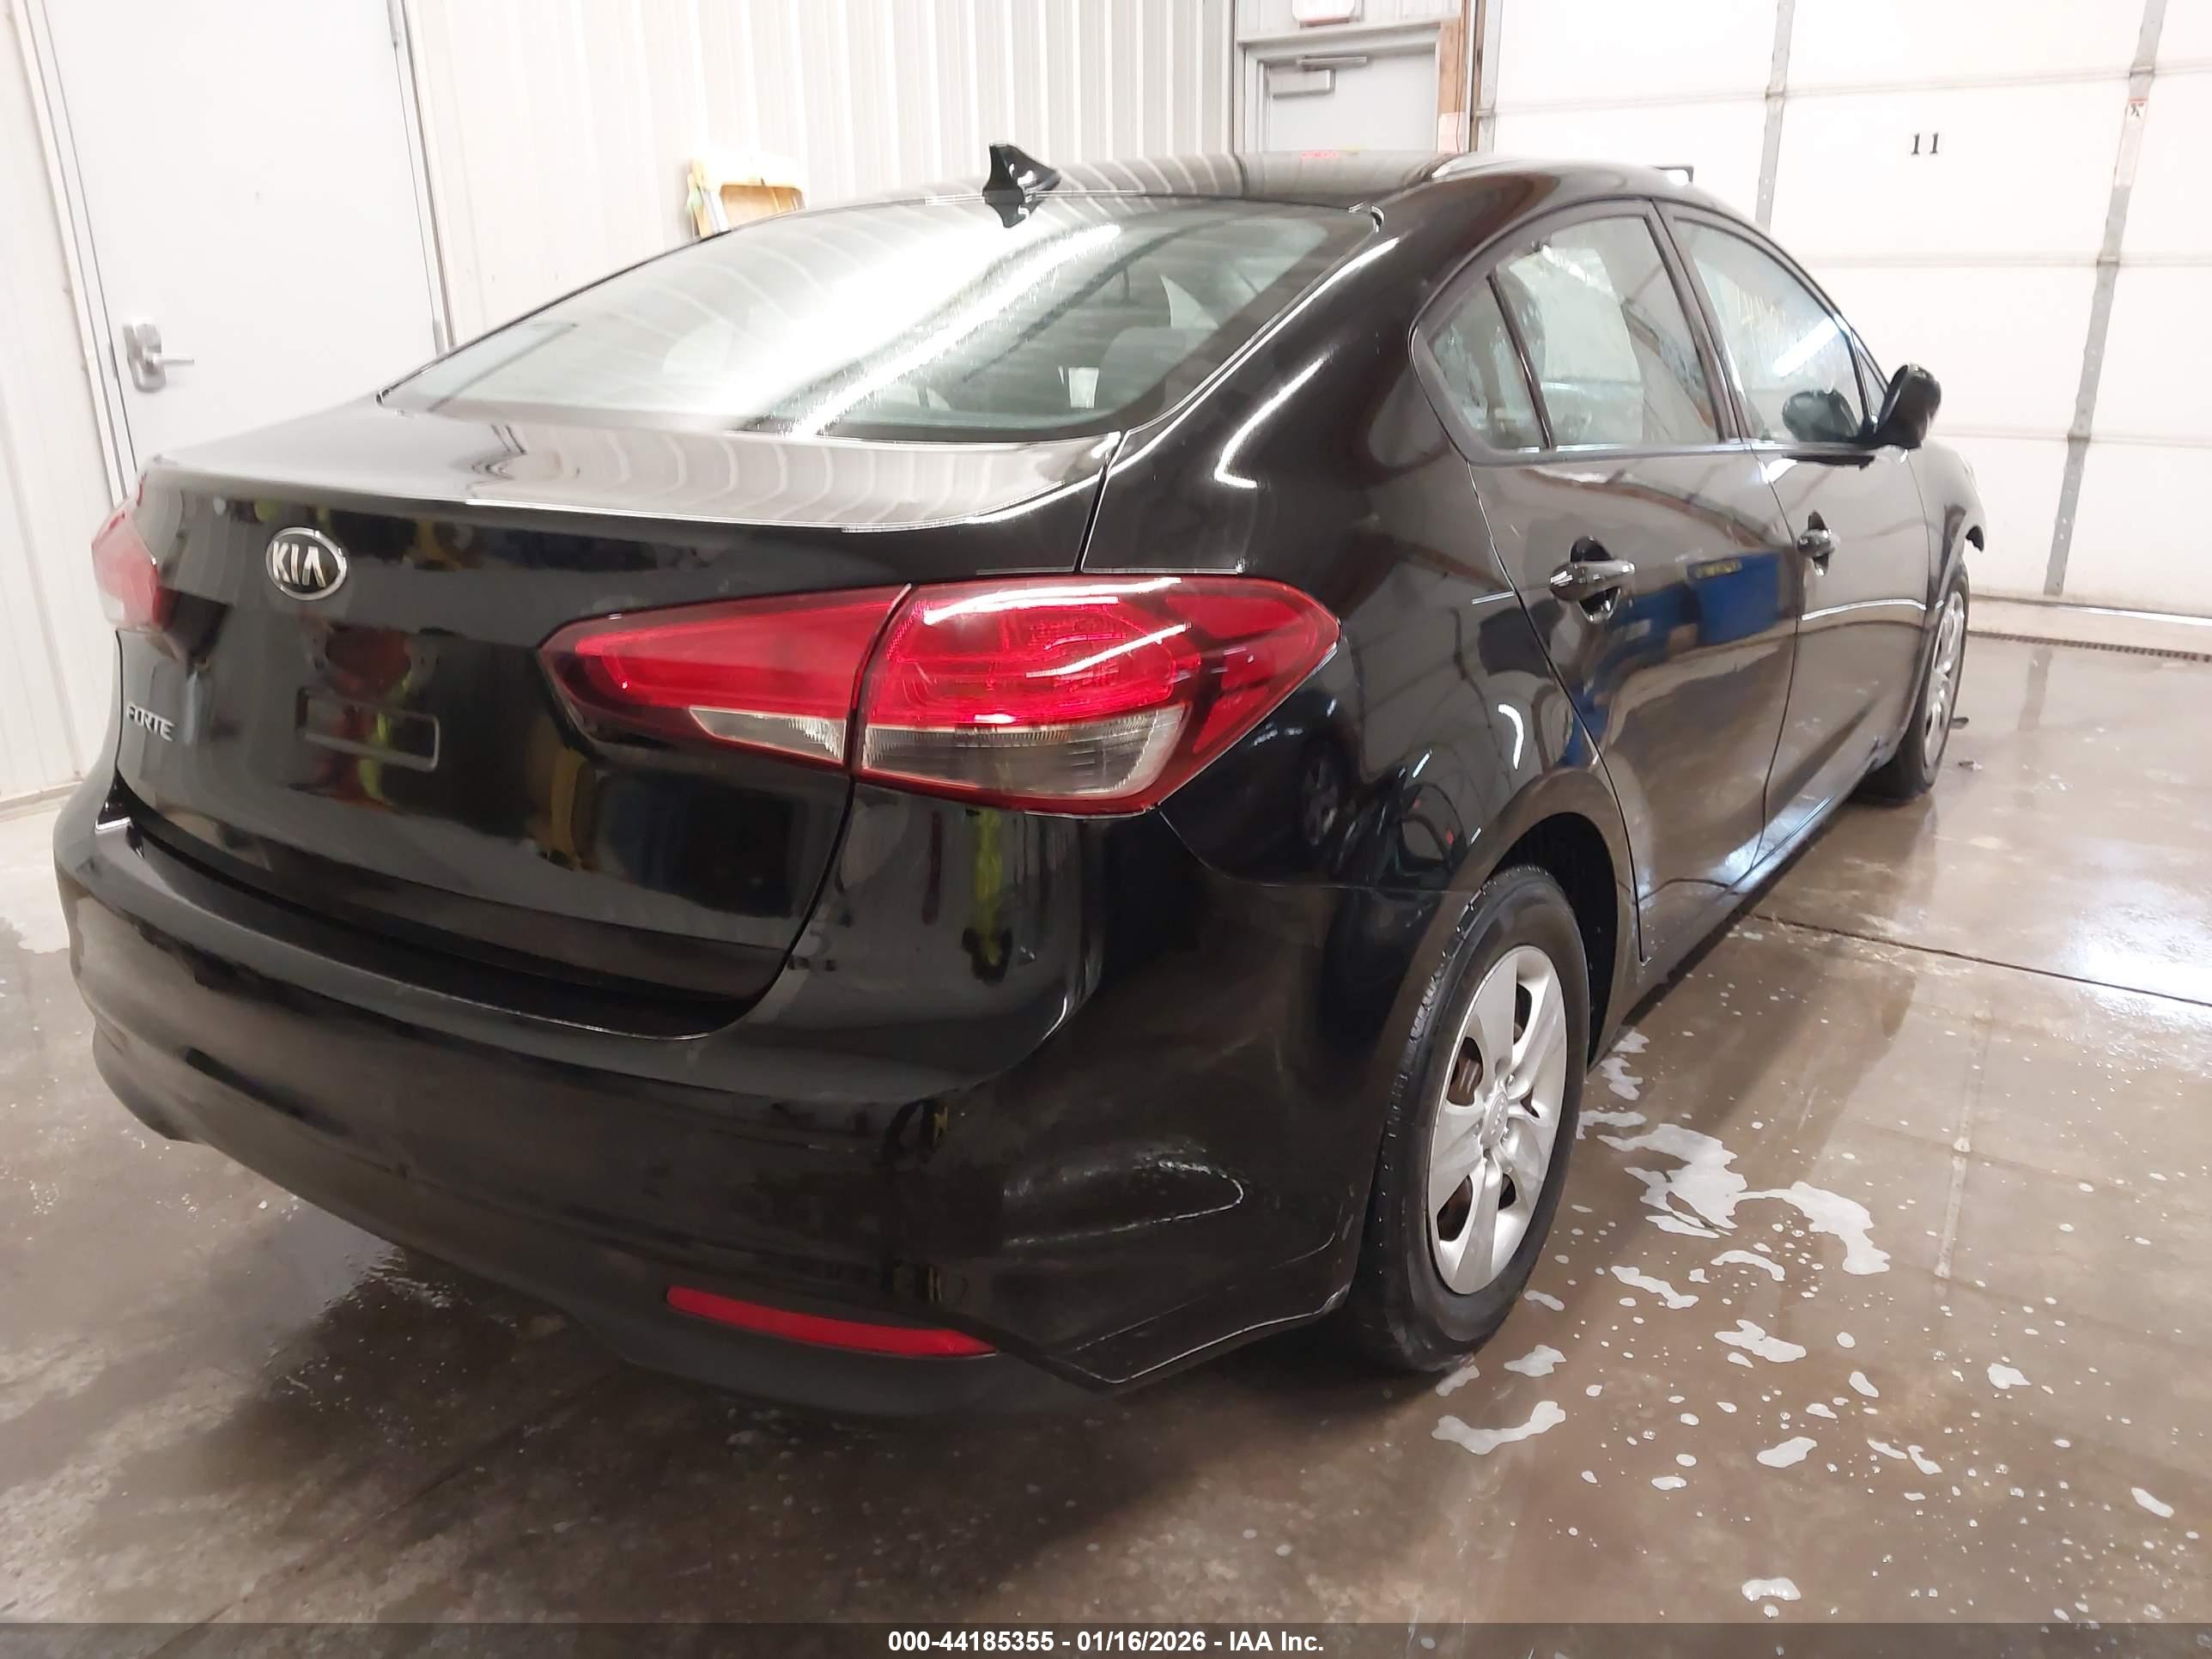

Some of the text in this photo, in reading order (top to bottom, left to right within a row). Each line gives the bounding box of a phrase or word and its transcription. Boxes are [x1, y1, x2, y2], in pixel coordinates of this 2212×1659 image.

[1911, 132, 1940, 155] 11
[272, 540, 326, 587] KIA
[126, 702, 176, 742] FORTE
